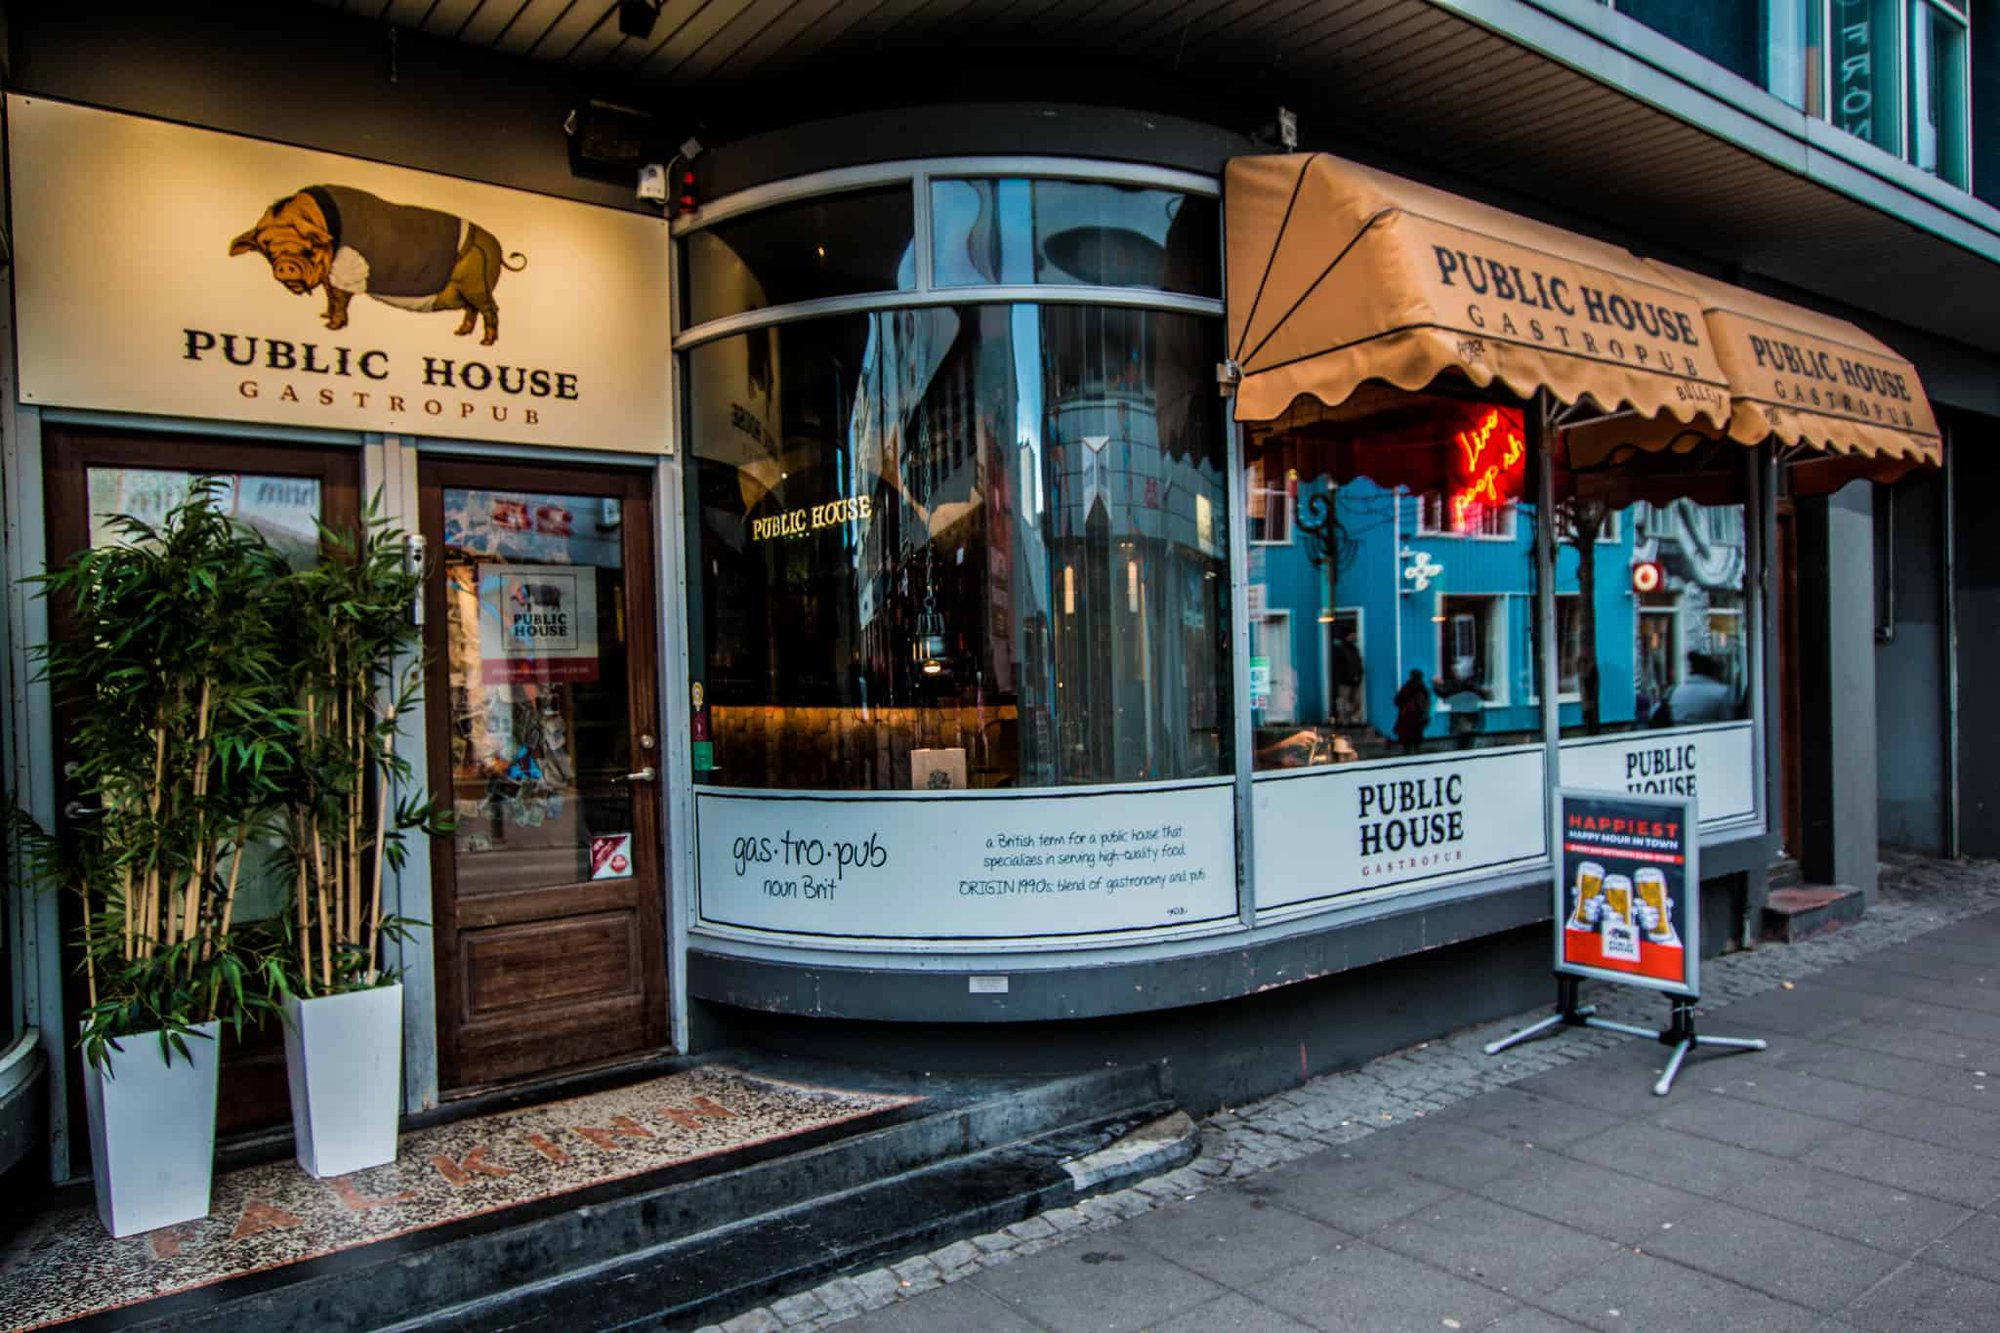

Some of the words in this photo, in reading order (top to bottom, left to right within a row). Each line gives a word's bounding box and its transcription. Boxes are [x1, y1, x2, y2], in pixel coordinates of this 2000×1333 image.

[1433, 245, 1575, 316] PUBLIC
[1580, 286, 1699, 347] HOUSE
[1467, 304, 1699, 377] GASTROPUB
[182, 329, 390, 380] PUBLIC
[421, 356, 580, 400] HOUSE
[1749, 335, 1837, 383] PUBLIC
[1838, 357, 1912, 402] HOUSE
[238, 380, 541, 425] GASTROPUB
[1774, 379, 1914, 427] GASTROPUB
[752, 508, 808, 541] PUBLIC
[810, 495, 873, 529] HOUSE
[513, 613, 568, 625] PUBLIC
[514, 625, 569, 637] HOUSE
[1625, 744, 1696, 779] PUBLIC
[1358, 774, 1462, 818] PUBLIC
[997, 832, 1035, 849] British
[1039, 833, 1066, 846] term
[1068, 831, 1087, 845] for
[1131, 828, 1159, 842] house
[1162, 824, 1183, 839] that
[1359, 811, 1464, 857] HOUSE
[1568, 830, 1600, 842] HAPPY
[1600, 833, 1631, 845] HOUR
[1631, 837, 1644, 847] IN
[1644, 838, 1680, 851] TOWN
[1569, 815, 1679, 838] HAPPIEST
[1057, 850, 1097, 869] serving
[1161, 843, 1187, 859] food
[1362, 850, 1462, 876] GASTROPUB
[763, 879, 797, 898] noun
[801, 874, 837, 901] Brit
[959, 879, 1015, 896] ORIGIN
[1056, 874, 1087, 893] blend
[1088, 876, 1103, 891] of
[1105, 874, 1167, 895] gastronomy
[1168, 870, 1188, 884] and
